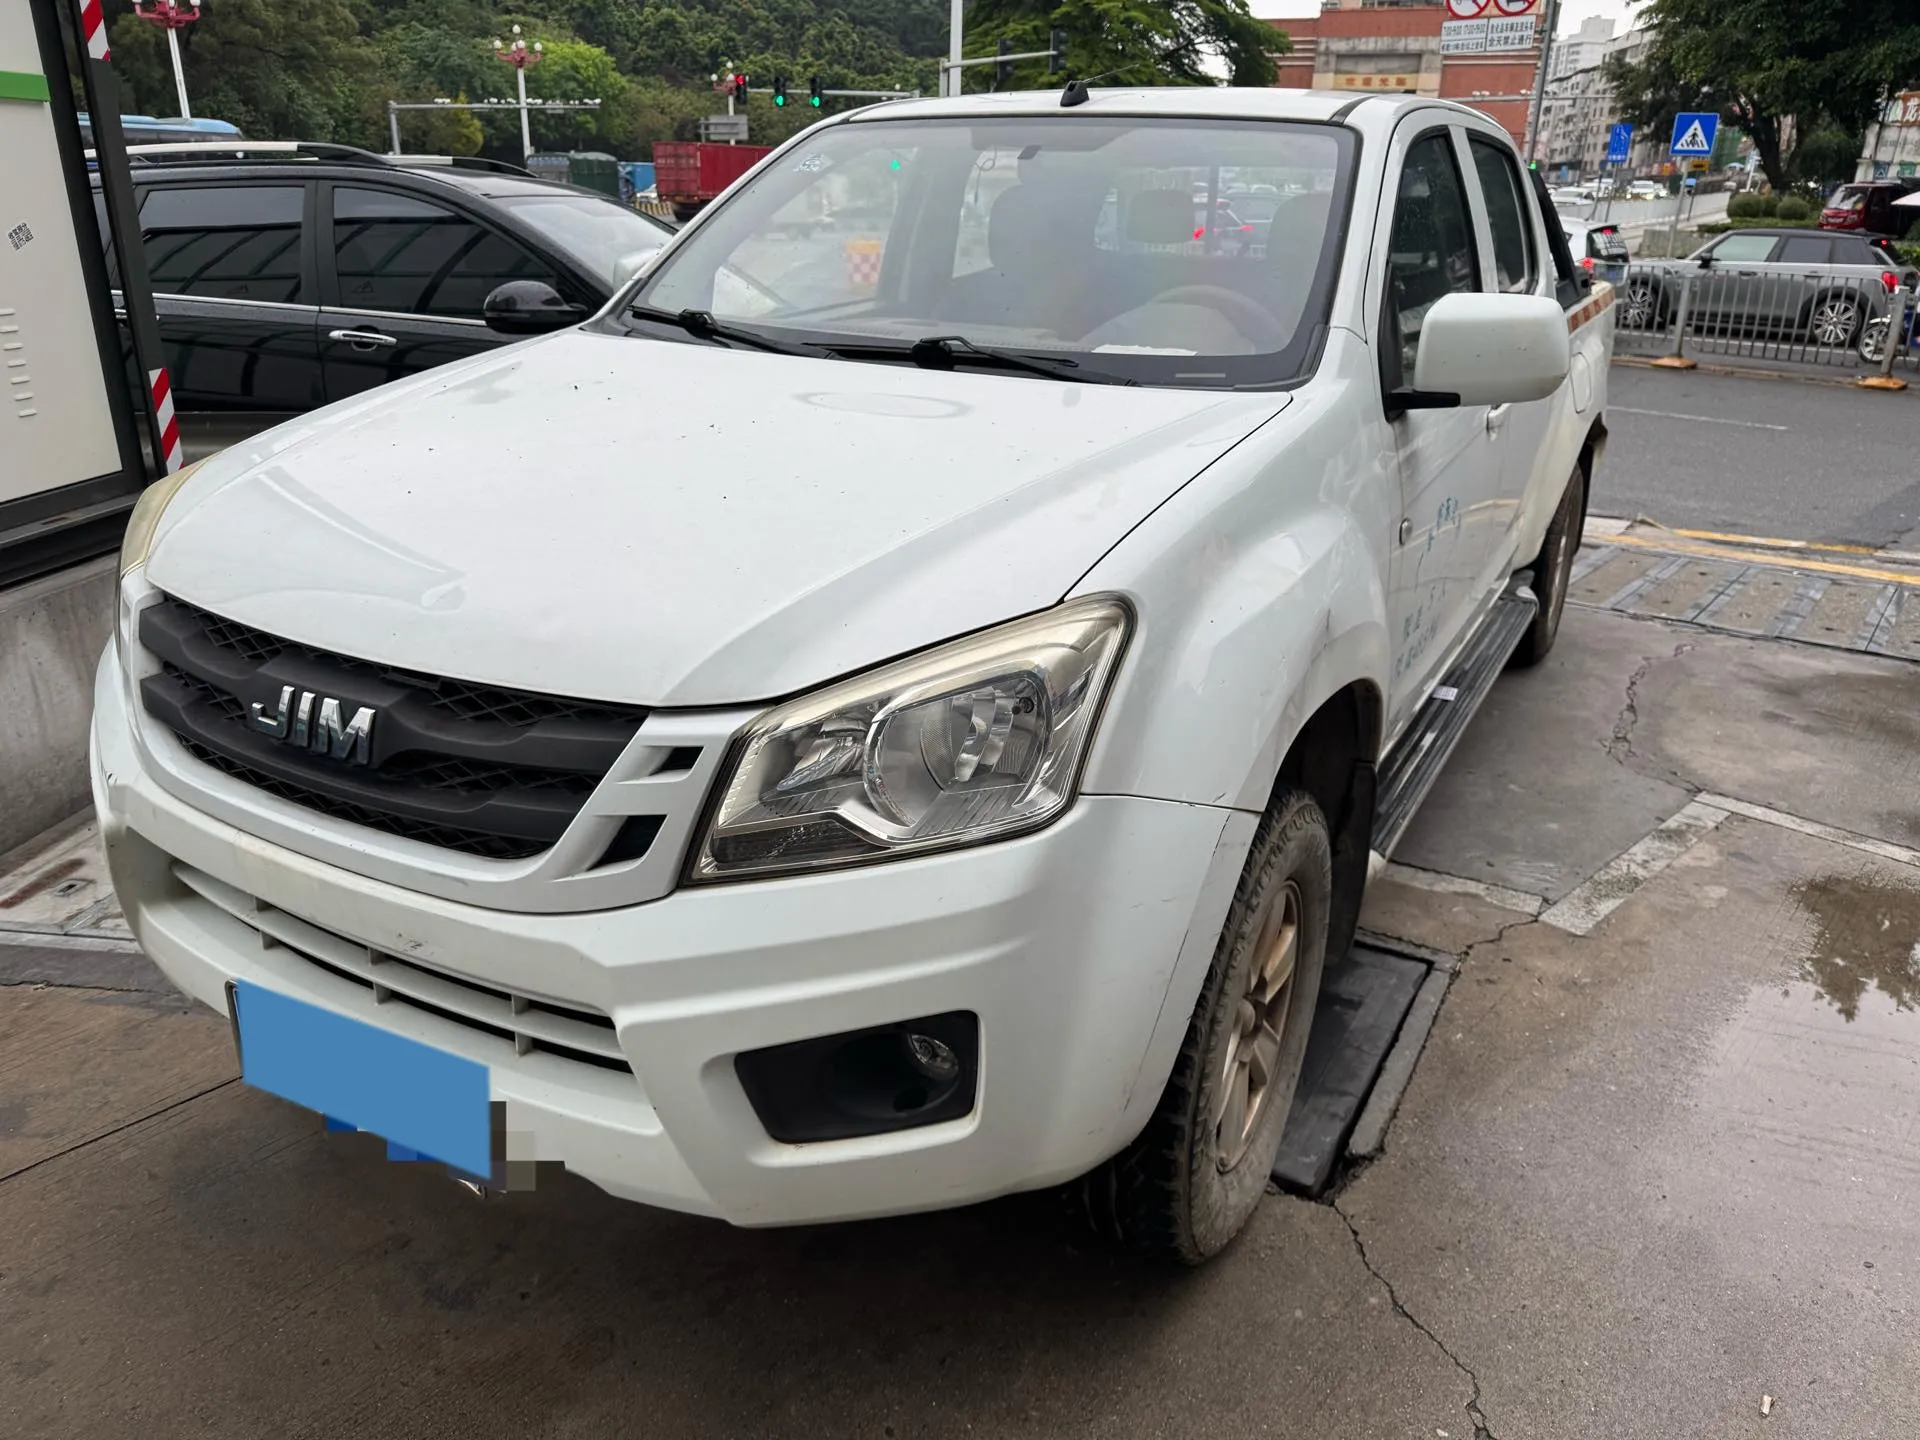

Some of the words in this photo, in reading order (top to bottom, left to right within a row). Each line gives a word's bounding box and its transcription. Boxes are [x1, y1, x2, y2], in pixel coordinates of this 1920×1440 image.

[1489, 34, 1532, 47] 全天禁止通行
[252, 685, 376, 765] JIM
